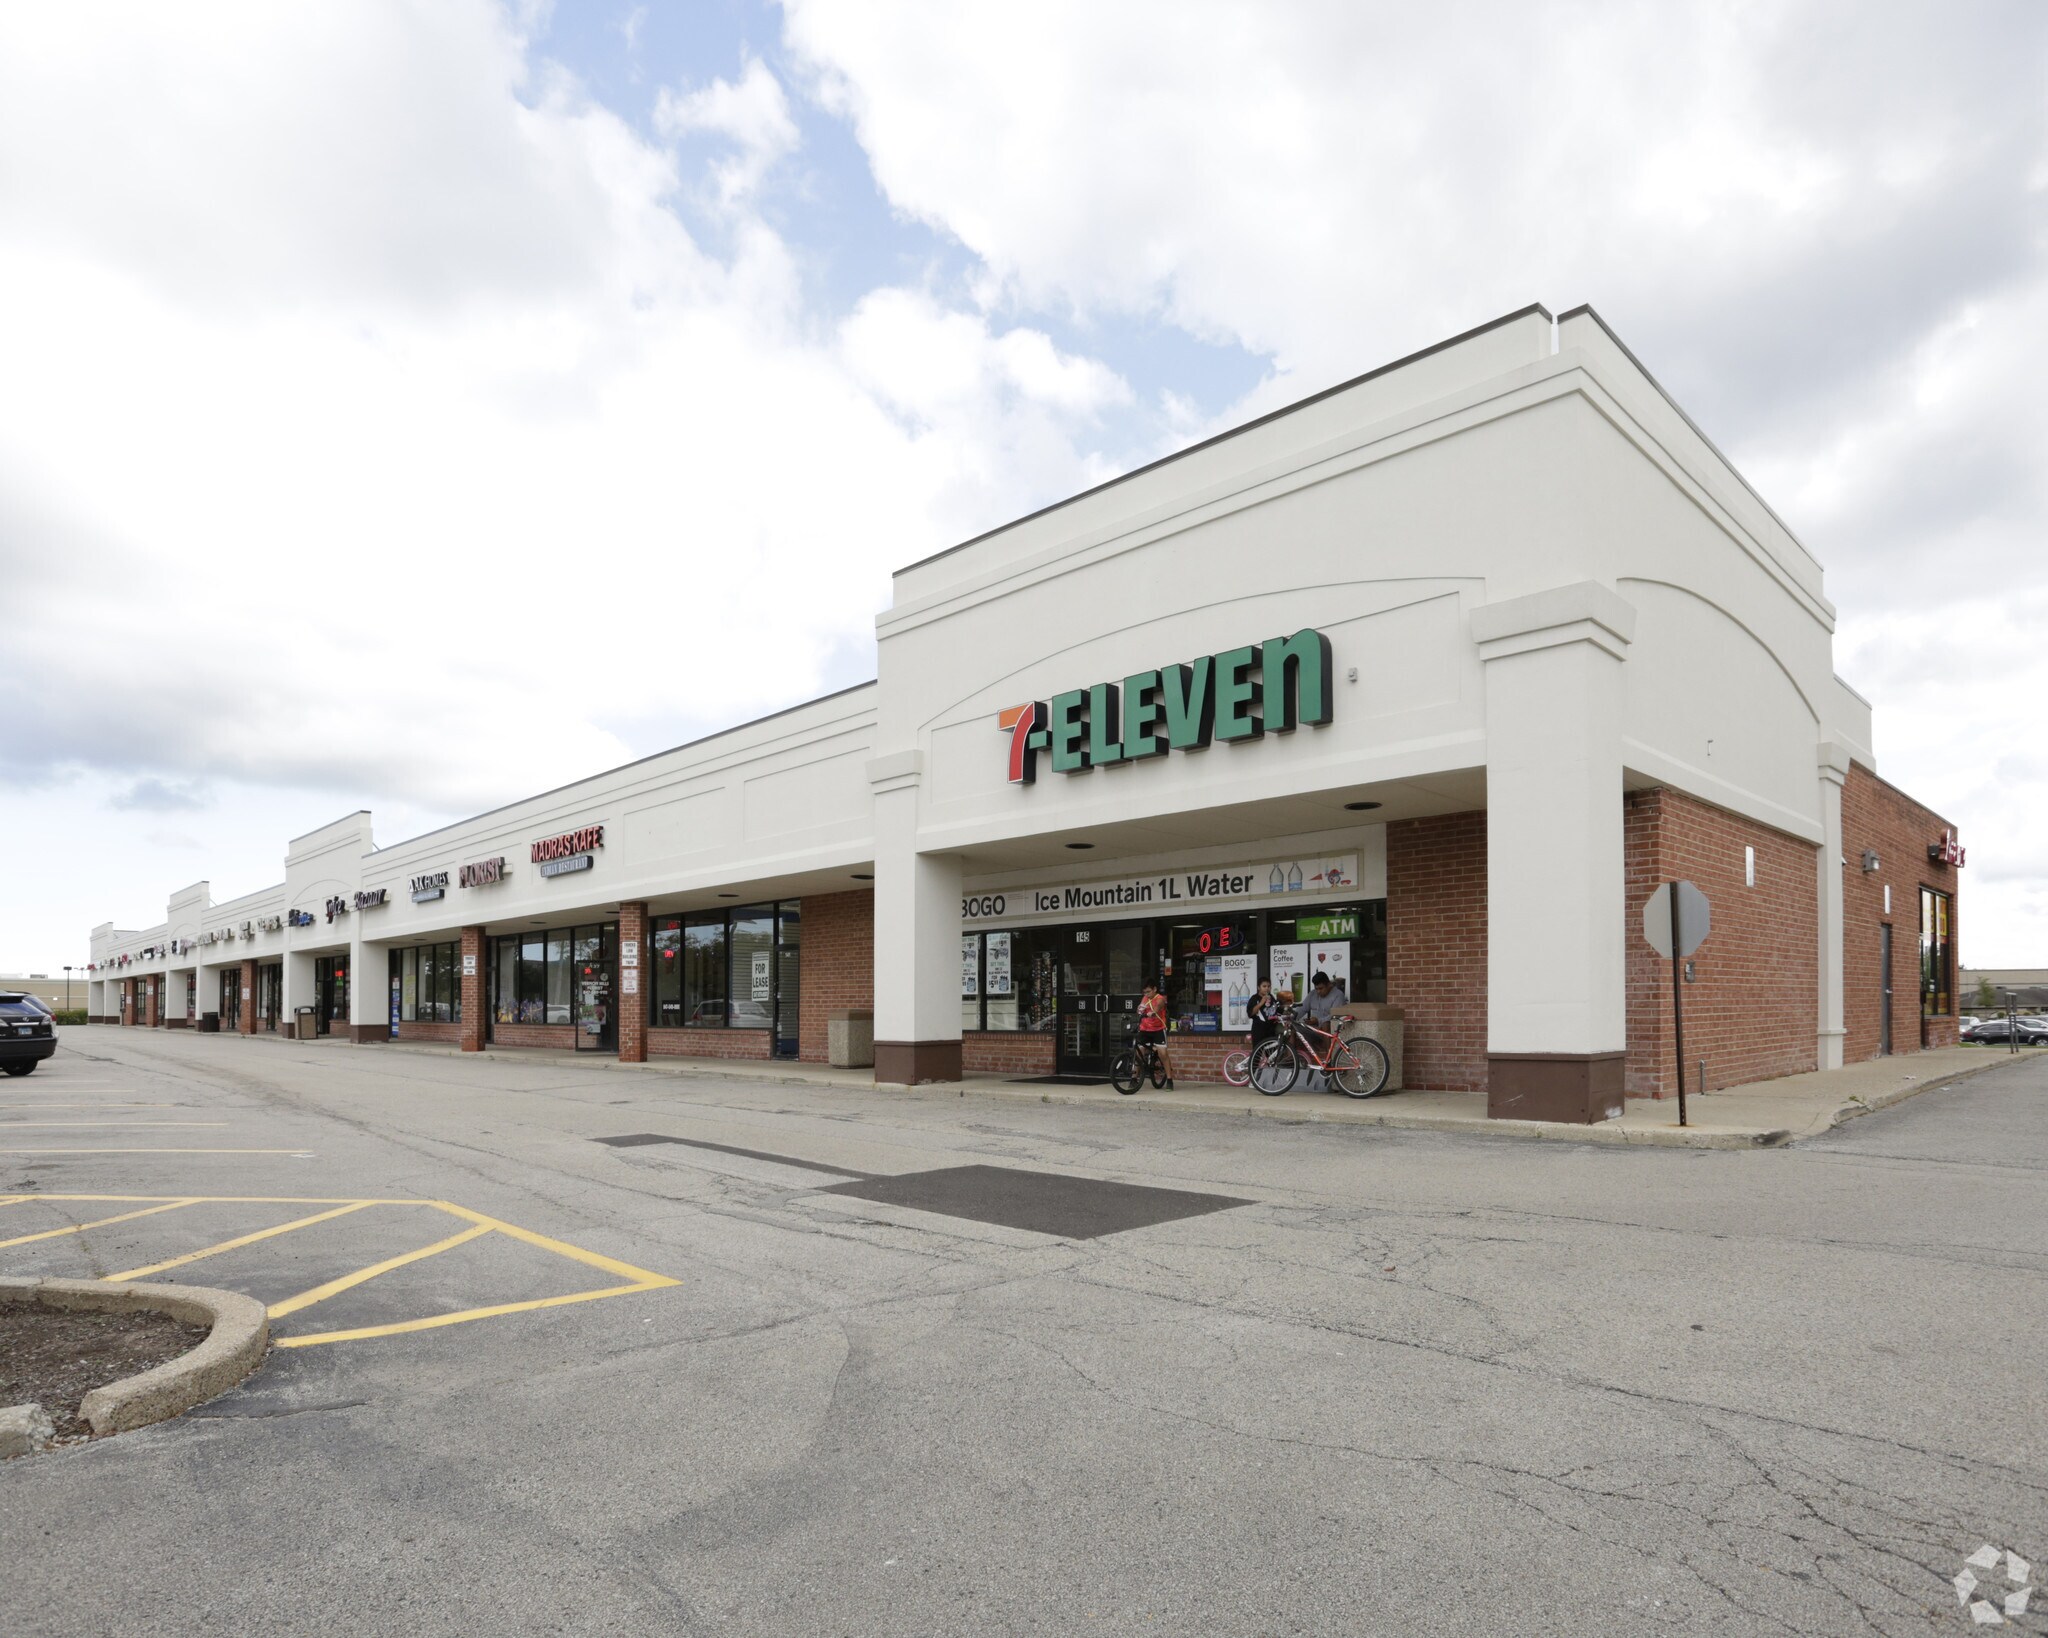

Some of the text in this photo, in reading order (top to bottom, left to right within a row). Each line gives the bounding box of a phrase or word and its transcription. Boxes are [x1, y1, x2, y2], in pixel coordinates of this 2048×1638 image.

[531, 826, 603, 863] MADRAS KAFE
[424, 872, 449, 889] HOMES
[459, 857, 504, 888] FLORIST
[1035, 892, 1060, 911] Ice
[1065, 881, 1151, 908] Mountain
[1159, 879, 1181, 899] 1L
[1187, 873, 1254, 897] Water
[1319, 918, 1355, 935] ATM
[1077, 931, 1089, 942] 145
[755, 963, 765, 974] FOR
[1224, 959, 1245, 967] BOGO
[753, 977, 768, 988] LEASE
